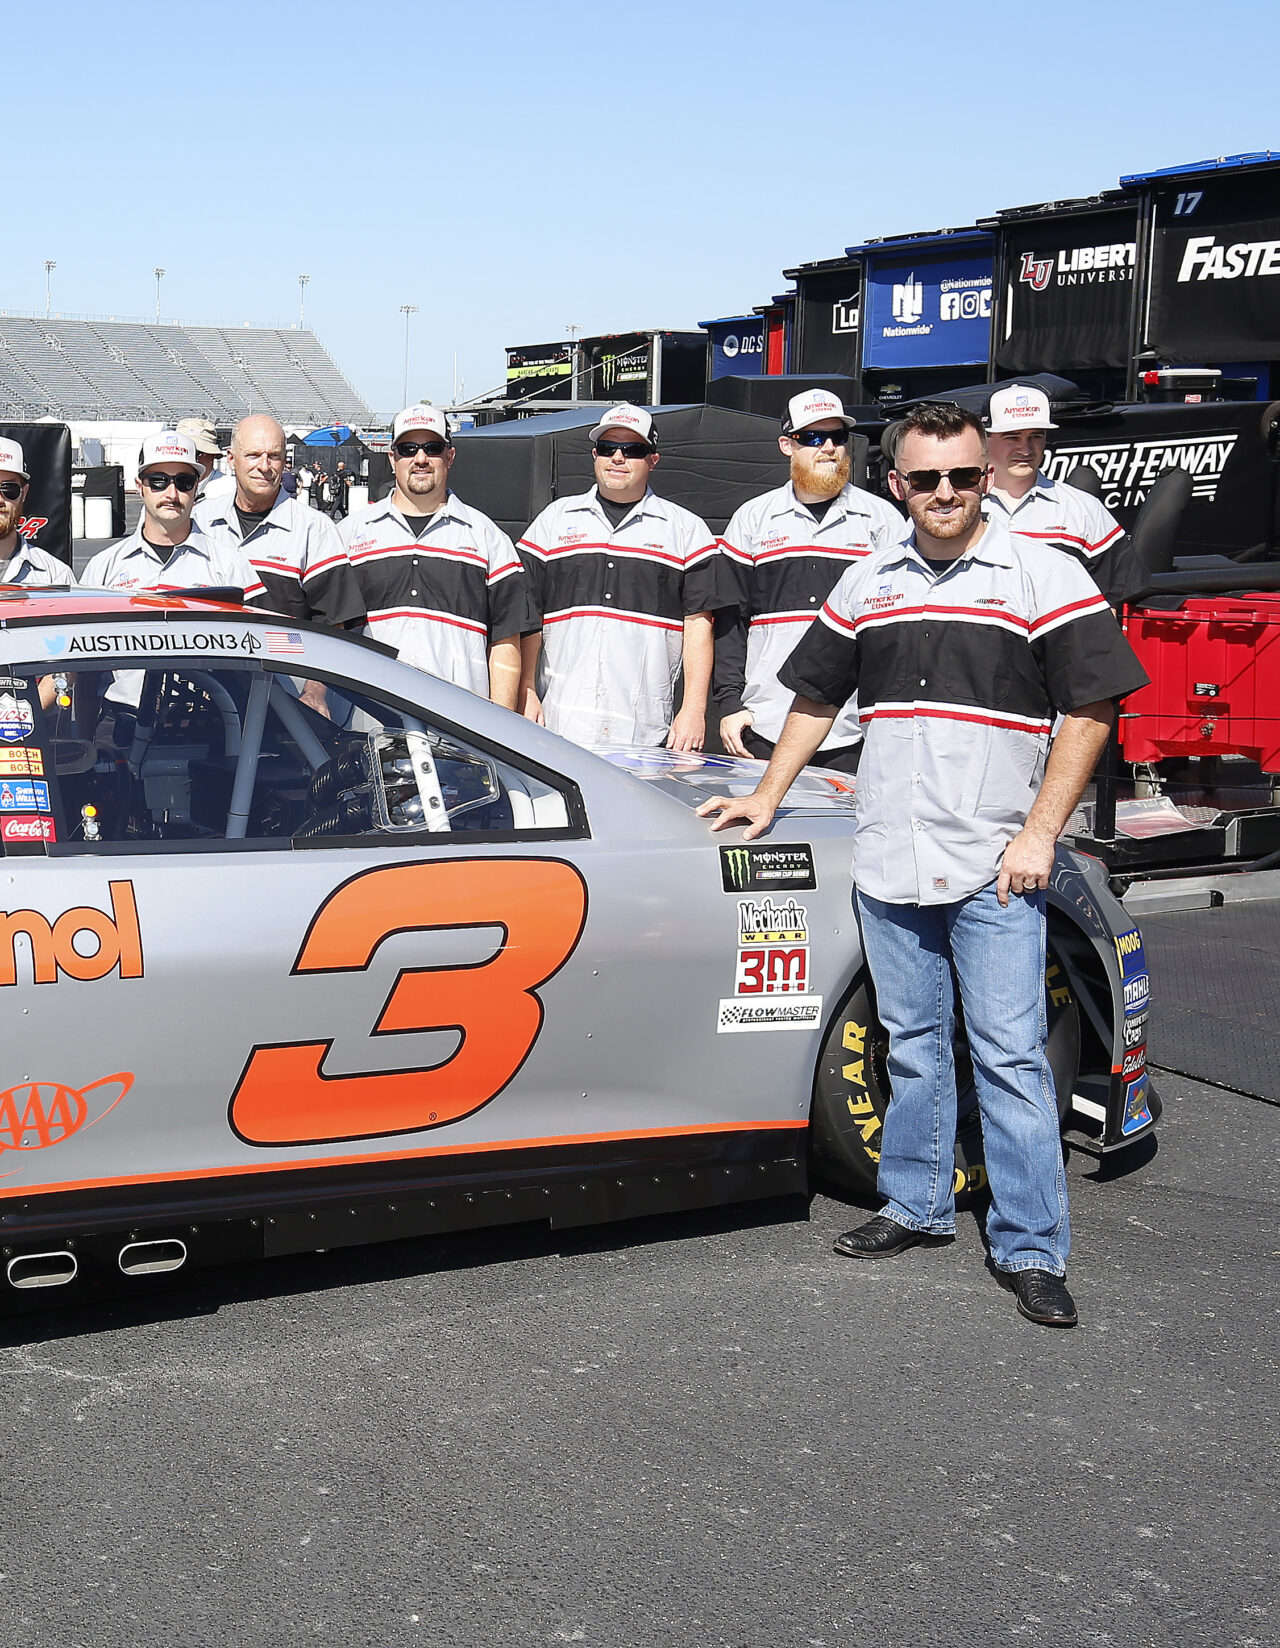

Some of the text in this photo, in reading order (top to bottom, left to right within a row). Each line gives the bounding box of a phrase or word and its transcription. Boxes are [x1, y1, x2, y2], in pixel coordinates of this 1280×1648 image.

[1174, 191, 1204, 216] 17
[1057, 242, 1136, 272] LIBERT
[1019, 252, 1054, 291] LU
[1057, 268, 1134, 286] UNIVERSI
[883, 324, 932, 338] Nationwide
[741, 336, 756, 354] DC
[803, 402, 837, 412] American
[1004, 406, 1040, 415] American
[403, 415, 436, 425] American
[608, 415, 639, 424] American
[155, 446, 189, 455] American
[1125, 435, 1238, 488] FENWAY
[1104, 488, 1152, 509] CIN
[558, 533, 588, 542] American
[760, 536, 790, 547] American
[349, 538, 377, 551] American
[863, 592, 905, 606] American
[871, 602, 895, 610] Ethanol
[68, 634, 238, 653] AUSTINDILLON3
[8, 750, 38, 759] BOSCH
[10, 763, 40, 772] BOSCH
[753, 851, 809, 864] MONSTER
[740, 899, 806, 934] Mechanix
[745, 932, 803, 942] WEAR
[1118, 930, 1141, 957] MOOG
[738, 949, 806, 993] 3M
[227, 854, 590, 1148] 3
[741, 1005, 820, 1017] FLOWMASTER
